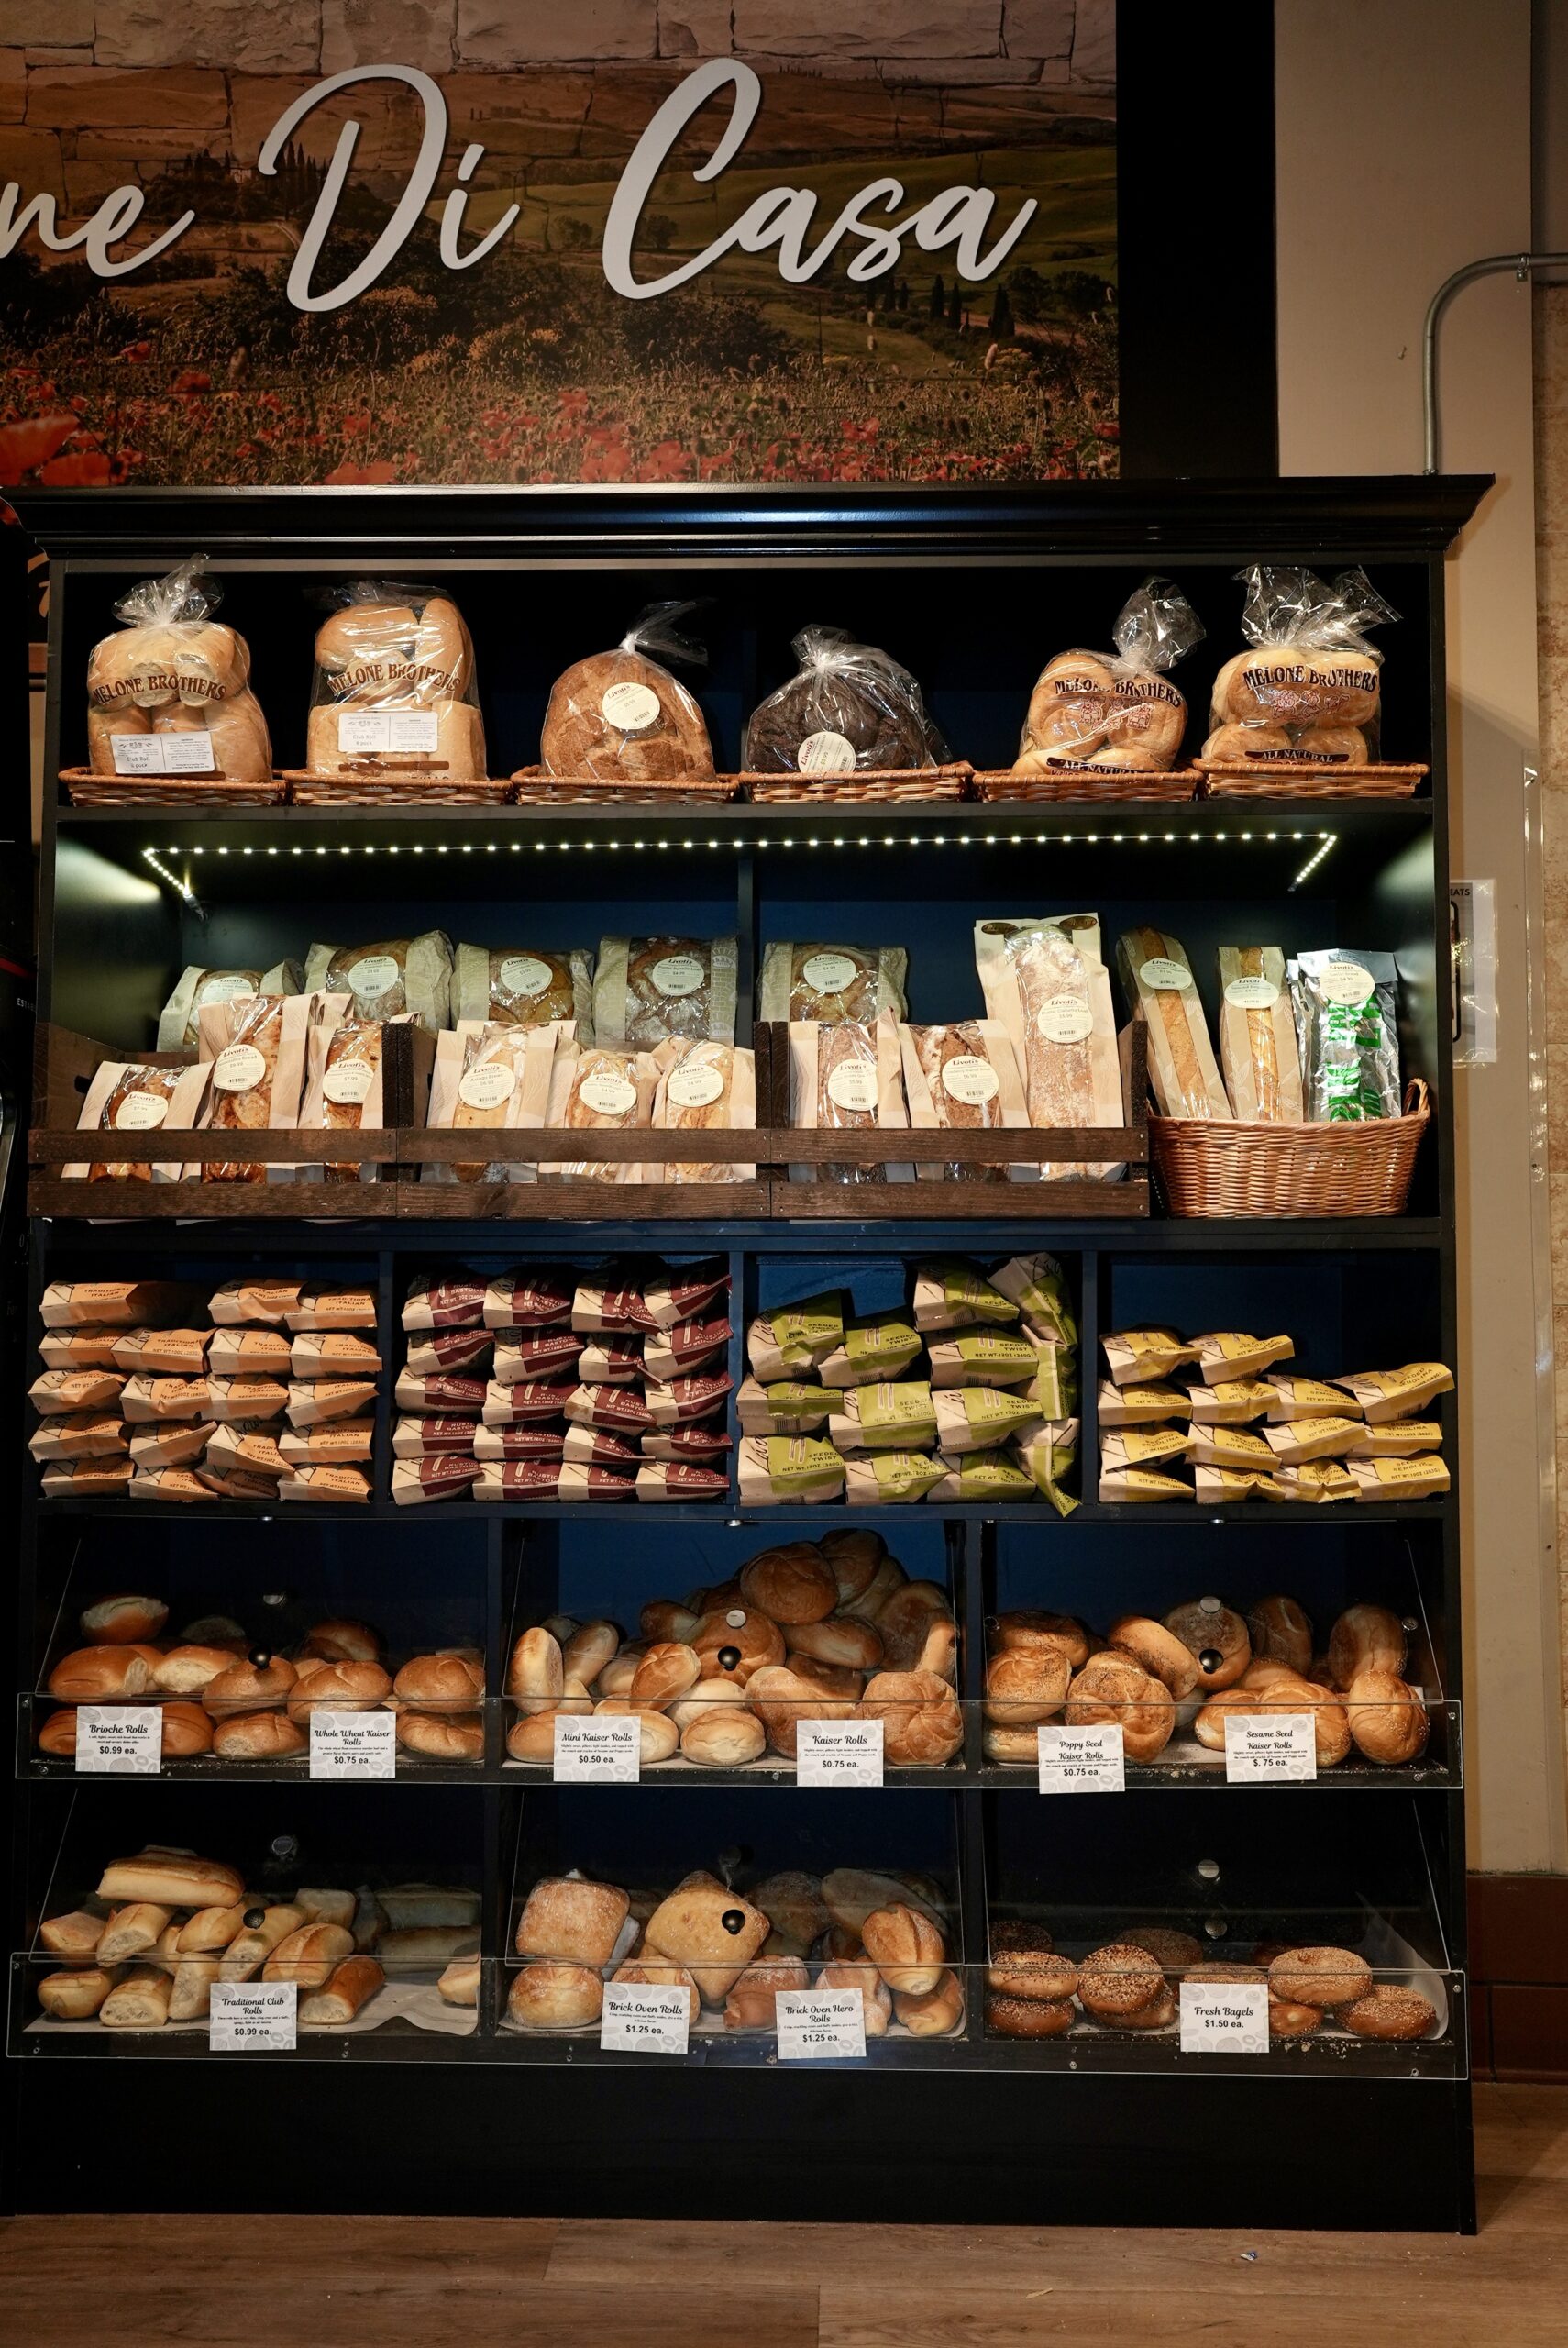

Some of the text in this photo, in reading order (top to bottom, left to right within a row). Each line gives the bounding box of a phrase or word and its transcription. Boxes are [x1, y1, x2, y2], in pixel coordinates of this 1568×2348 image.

[258, 63, 520, 313] Di
[602, 57, 1039, 300] Casa
[327, 663, 461, 697] MELONE BROTHERS
[1242, 665, 1378, 693] MELONE BROTHERS
[93, 674, 226, 704] MELONE BROTHERS
[1262, 749, 1333, 763] ALL NATURAL
[1062, 760, 1084, 771] ALL
[885, 1334, 922, 1343] SEEDED
[89, 1724, 149, 1733] Brioche Rolls
[366, 1729, 391, 1737] Kaiser
[561, 1733, 633, 1742] Mini Kaiser Rolls
[1246, 1729, 1294, 1738] Sesame Seed
[812, 1735, 867, 1744] Kaiser Rolls
[1059, 1739, 1103, 1751] Poppy Seed
[1246, 1741, 1293, 1750] Kaiser Rolls
[99, 1745, 122, 1755] $0.99
[334, 1755, 357, 1765] $0.75
[579, 1755, 602, 1764] $0.50
[1058, 1751, 1104, 1760] Kaiser Rolls
[822, 1760, 845, 1768] $0.75
[1064, 1767, 1087, 1777] $0.75
[221, 1997, 284, 2006] Traditional Club
[242, 2006, 263, 2015] Rolls
[608, 2001, 683, 2015] Brick Oven Rolls
[785, 2004, 854, 2015] Brick Oven Hero
[1194, 2006, 1253, 2020] Fresh Bagels
[809, 2014, 831, 2023] Rolls
[1205, 2019, 1229, 2028] $1.50
[234, 2028, 257, 2036] $0.99
[625, 2024, 665, 2035] $1.25 ea.
[802, 2034, 825, 2043] $1.25
